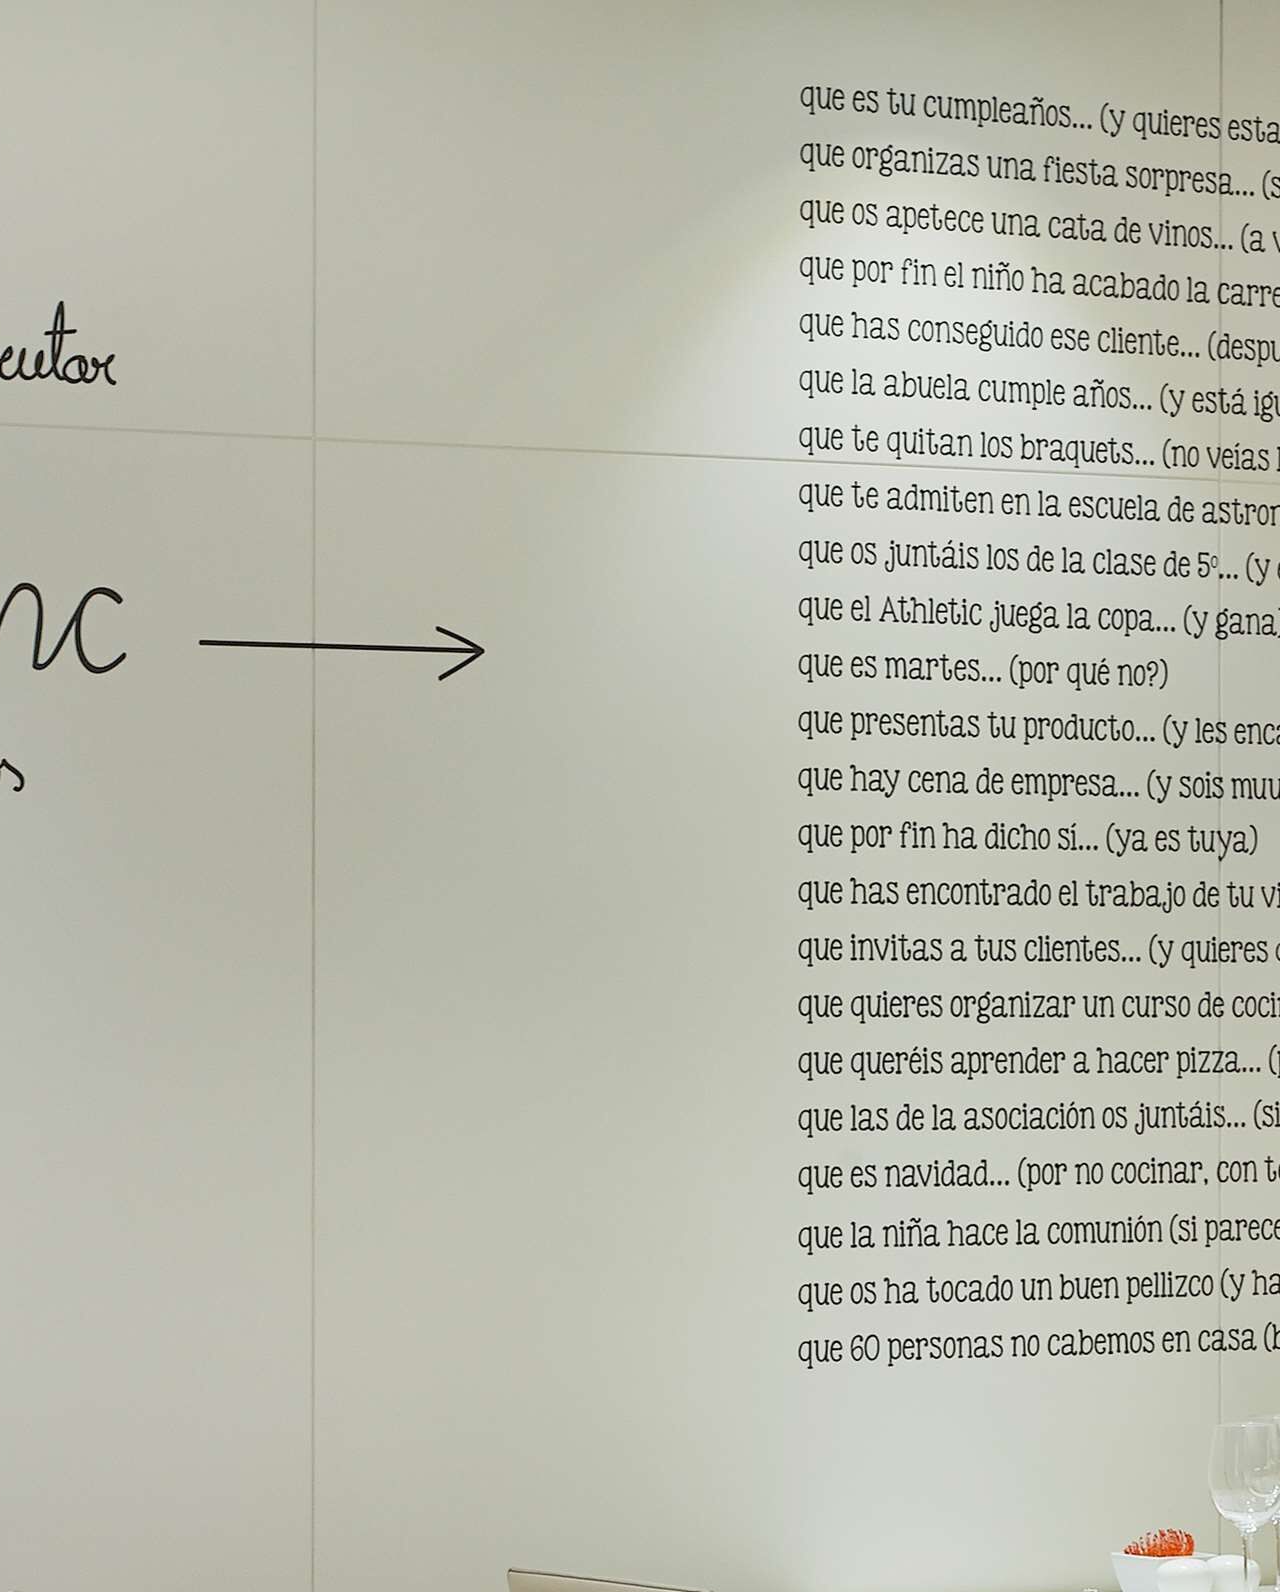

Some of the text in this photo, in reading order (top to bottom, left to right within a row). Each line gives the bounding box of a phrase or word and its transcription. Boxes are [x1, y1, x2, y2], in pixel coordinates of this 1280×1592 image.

[799, 85, 846, 116] que
[851, 89, 880, 114] es
[885, 87, 917, 117] tu
[923, 94, 1093, 130] cumpleaños...
[1099, 102, 1126, 138] (y
[1132, 108, 1222, 141] quieres
[799, 199, 845, 230] que
[851, 202, 879, 227] os
[885, 203, 985, 235] apetece
[990, 211, 1041, 238] una
[1047, 213, 1108, 243] cata
[1113, 216, 1142, 245] de
[1148, 219, 1234, 251] vinos...
[1240, 222, 1267, 255] (a
[799, 312, 845, 343] que
[850, 311, 901, 341] has
[907, 318, 1044, 353] conseguido
[1050, 327, 1091, 352] ese
[1097, 326, 1200, 359] cliente...
[798, 482, 844, 513] que
[850, 480, 879, 510] te
[886, 483, 995, 515] admiten
[1000, 492, 1031, 516] en
[1037, 489, 1063, 518] la
[1068, 494, 1161, 522] escuela
[1167, 495, 1195, 524] de
[798, 596, 844, 627] que
[850, 594, 872, 623] el
[878, 595, 983, 627] Athletic
[989, 599, 1061, 635] juega
[1066, 602, 1092, 631] la
[1097, 607, 1176, 638] copa...
[1183, 604, 1209, 640] (y
[797, 710, 844, 741] que
[850, 709, 981, 742] presentas
[986, 711, 1017, 740] tu
[1022, 713, 1156, 746] producto...
[1162, 713, 1189, 750] (y
[1194, 717, 1228, 745] les
[797, 820, 1258, 863] que por fin ha dicho sí... (ya es tuya)
[797, 937, 844, 968] que
[849, 933, 944, 962] invitas
[950, 938, 968, 963] a
[973, 934, 1017, 962] tus
[1023, 934, 1142, 963] clientes...
[1148, 933, 1175, 969] (y
[1180, 935, 1269, 970] quieres
[797, 1051, 844, 1082] que
[850, 1045, 944, 1082] queréis
[950, 1046, 1066, 1081] aprender
[1073, 1050, 1091, 1075] a
[1095, 1046, 1170, 1074] hacer
[1175, 1046, 1262, 1080] pizza...
[797, 1164, 844, 1196] que
[850, 1164, 878, 1189] es
[883, 1158, 1010, 1188] navidad...
[1017, 1156, 1068, 1193] (por
[1074, 1162, 1104, 1186] no
[1110, 1156, 1209, 1186] cocinar,
[1216, 1159, 1259, 1184] con
[797, 1339, 844, 1370] que
[849, 1333, 881, 1362] 60
[886, 1334, 1004, 1368] personas
[1010, 1334, 1041, 1358] no
[1047, 1328, 1156, 1357] cabemos
[1161, 1329, 1192, 1354] en
[1197, 1328, 1258, 1353] casa
